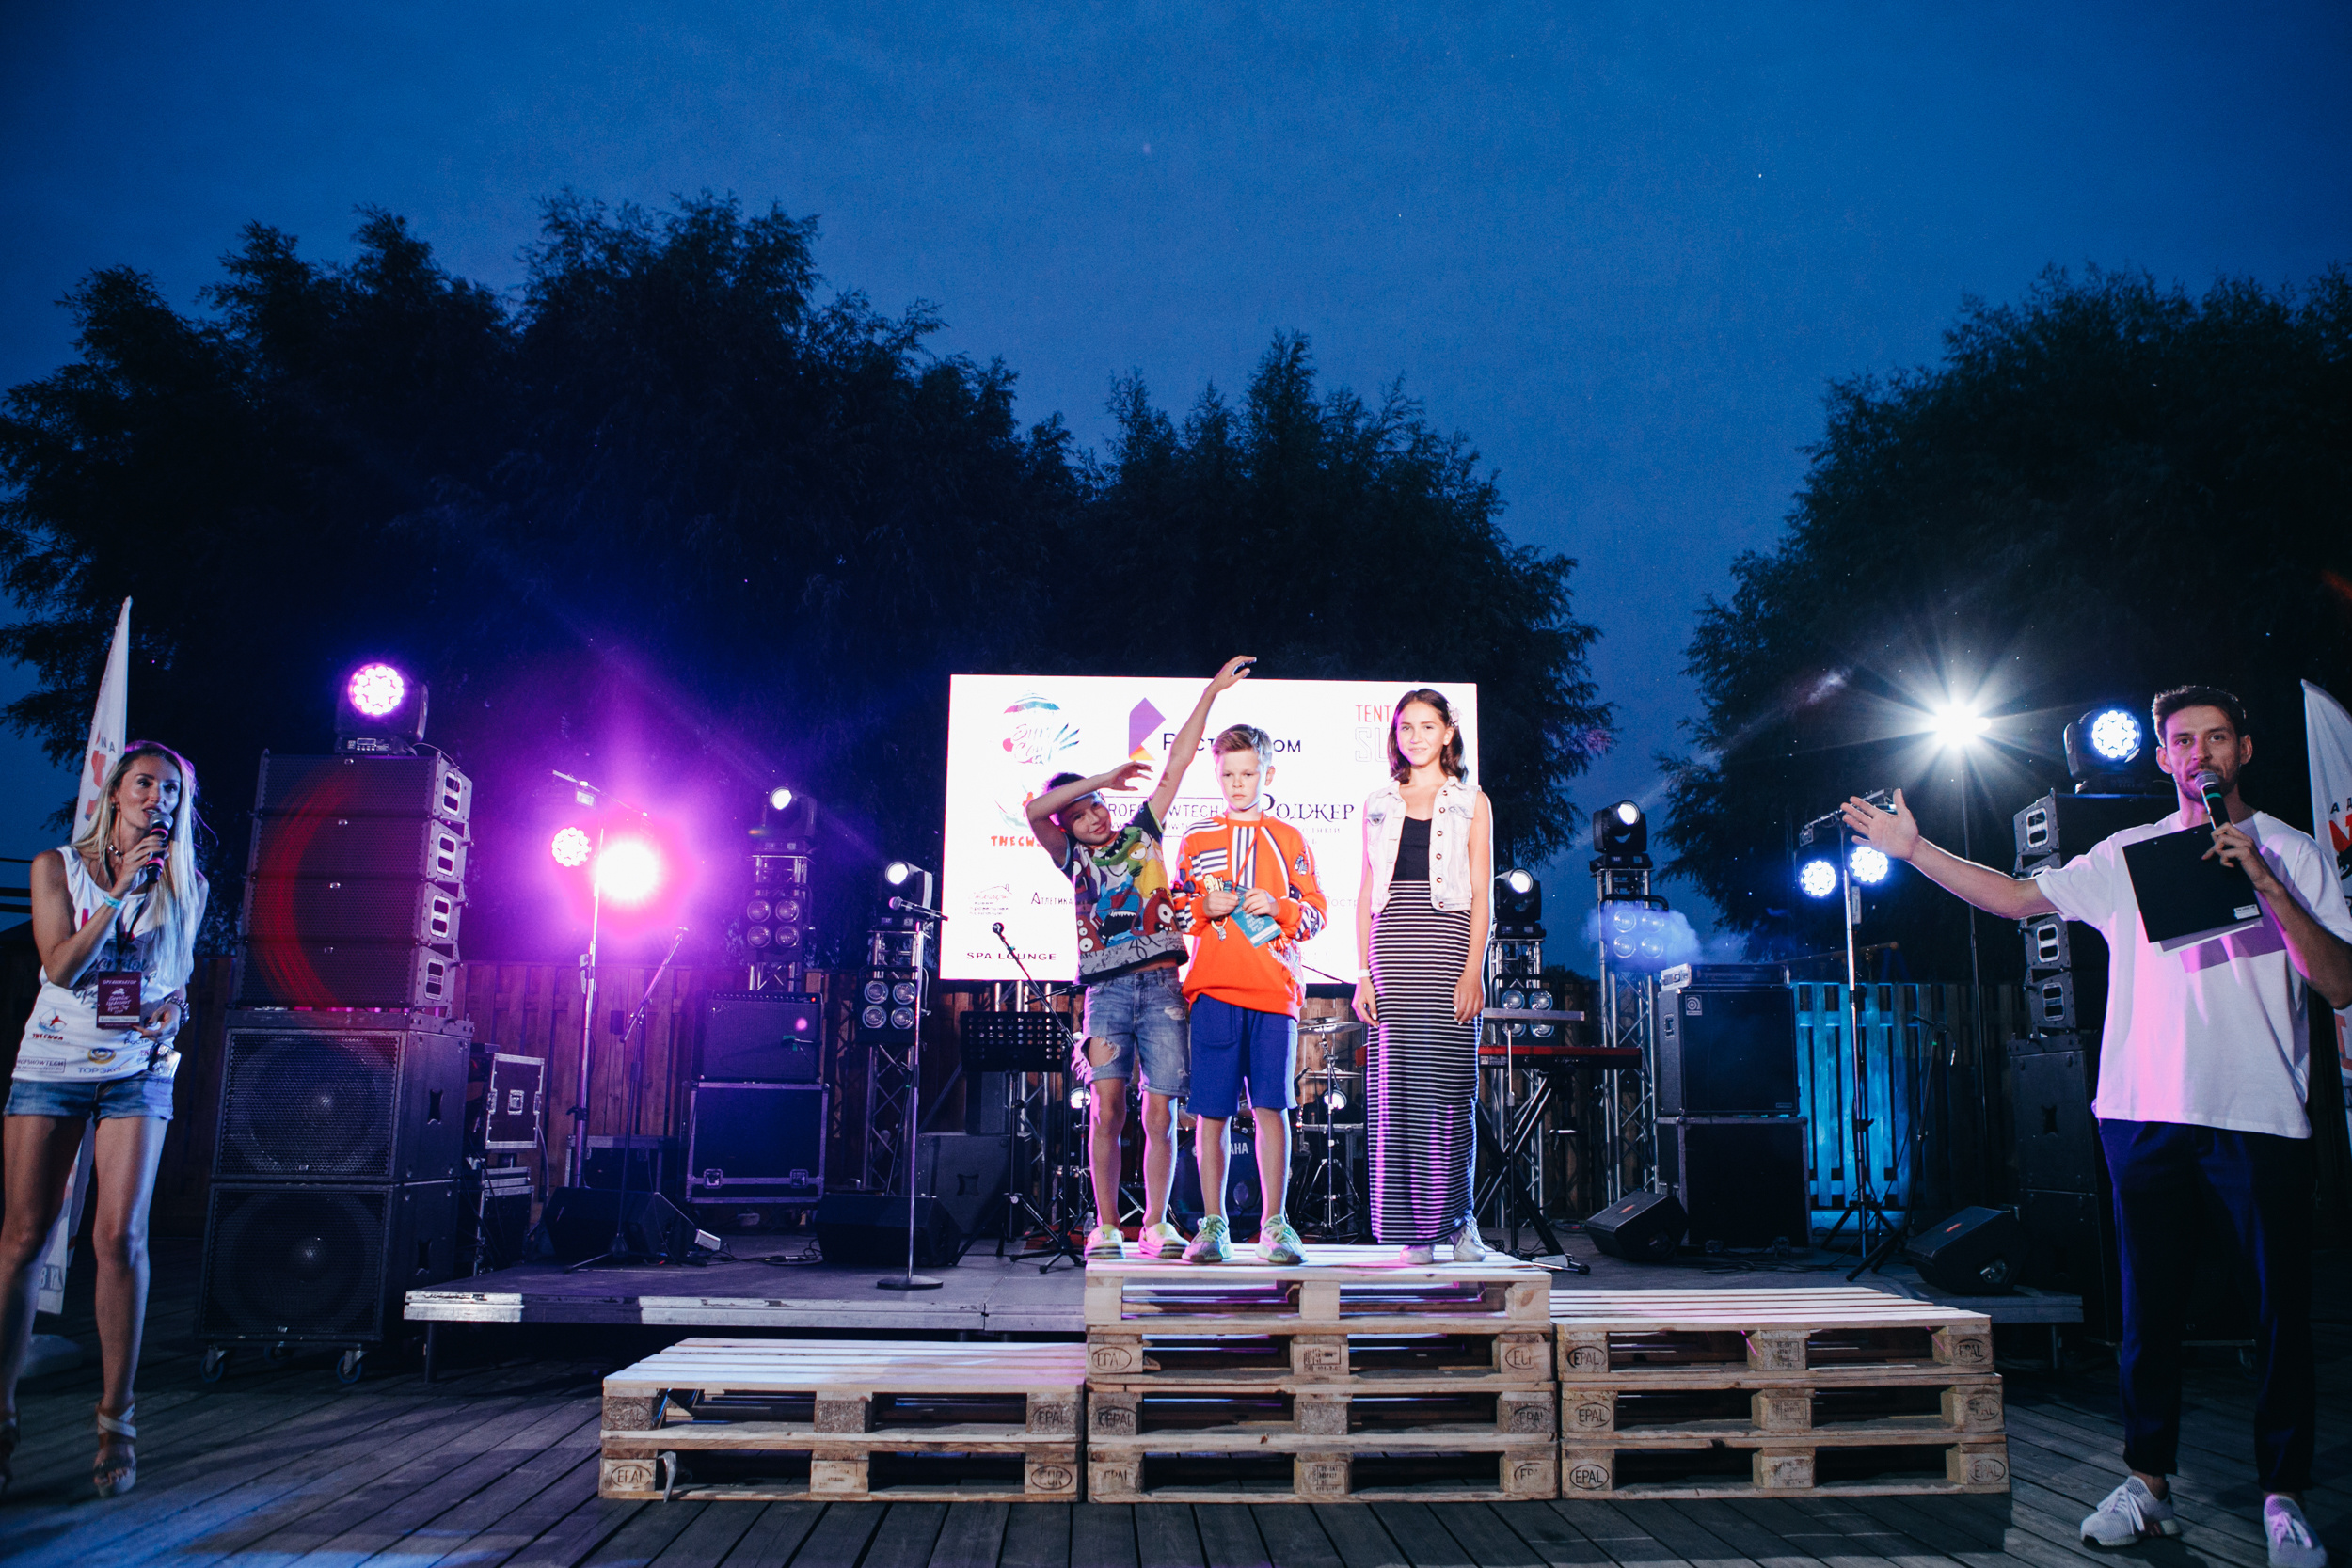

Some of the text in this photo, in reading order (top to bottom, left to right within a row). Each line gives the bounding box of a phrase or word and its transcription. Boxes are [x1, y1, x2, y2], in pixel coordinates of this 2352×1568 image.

[1573, 1352, 1599, 1365] EPAL
[1579, 1409, 1606, 1422] EPAL
[1575, 1469, 1603, 1483] EPAL
